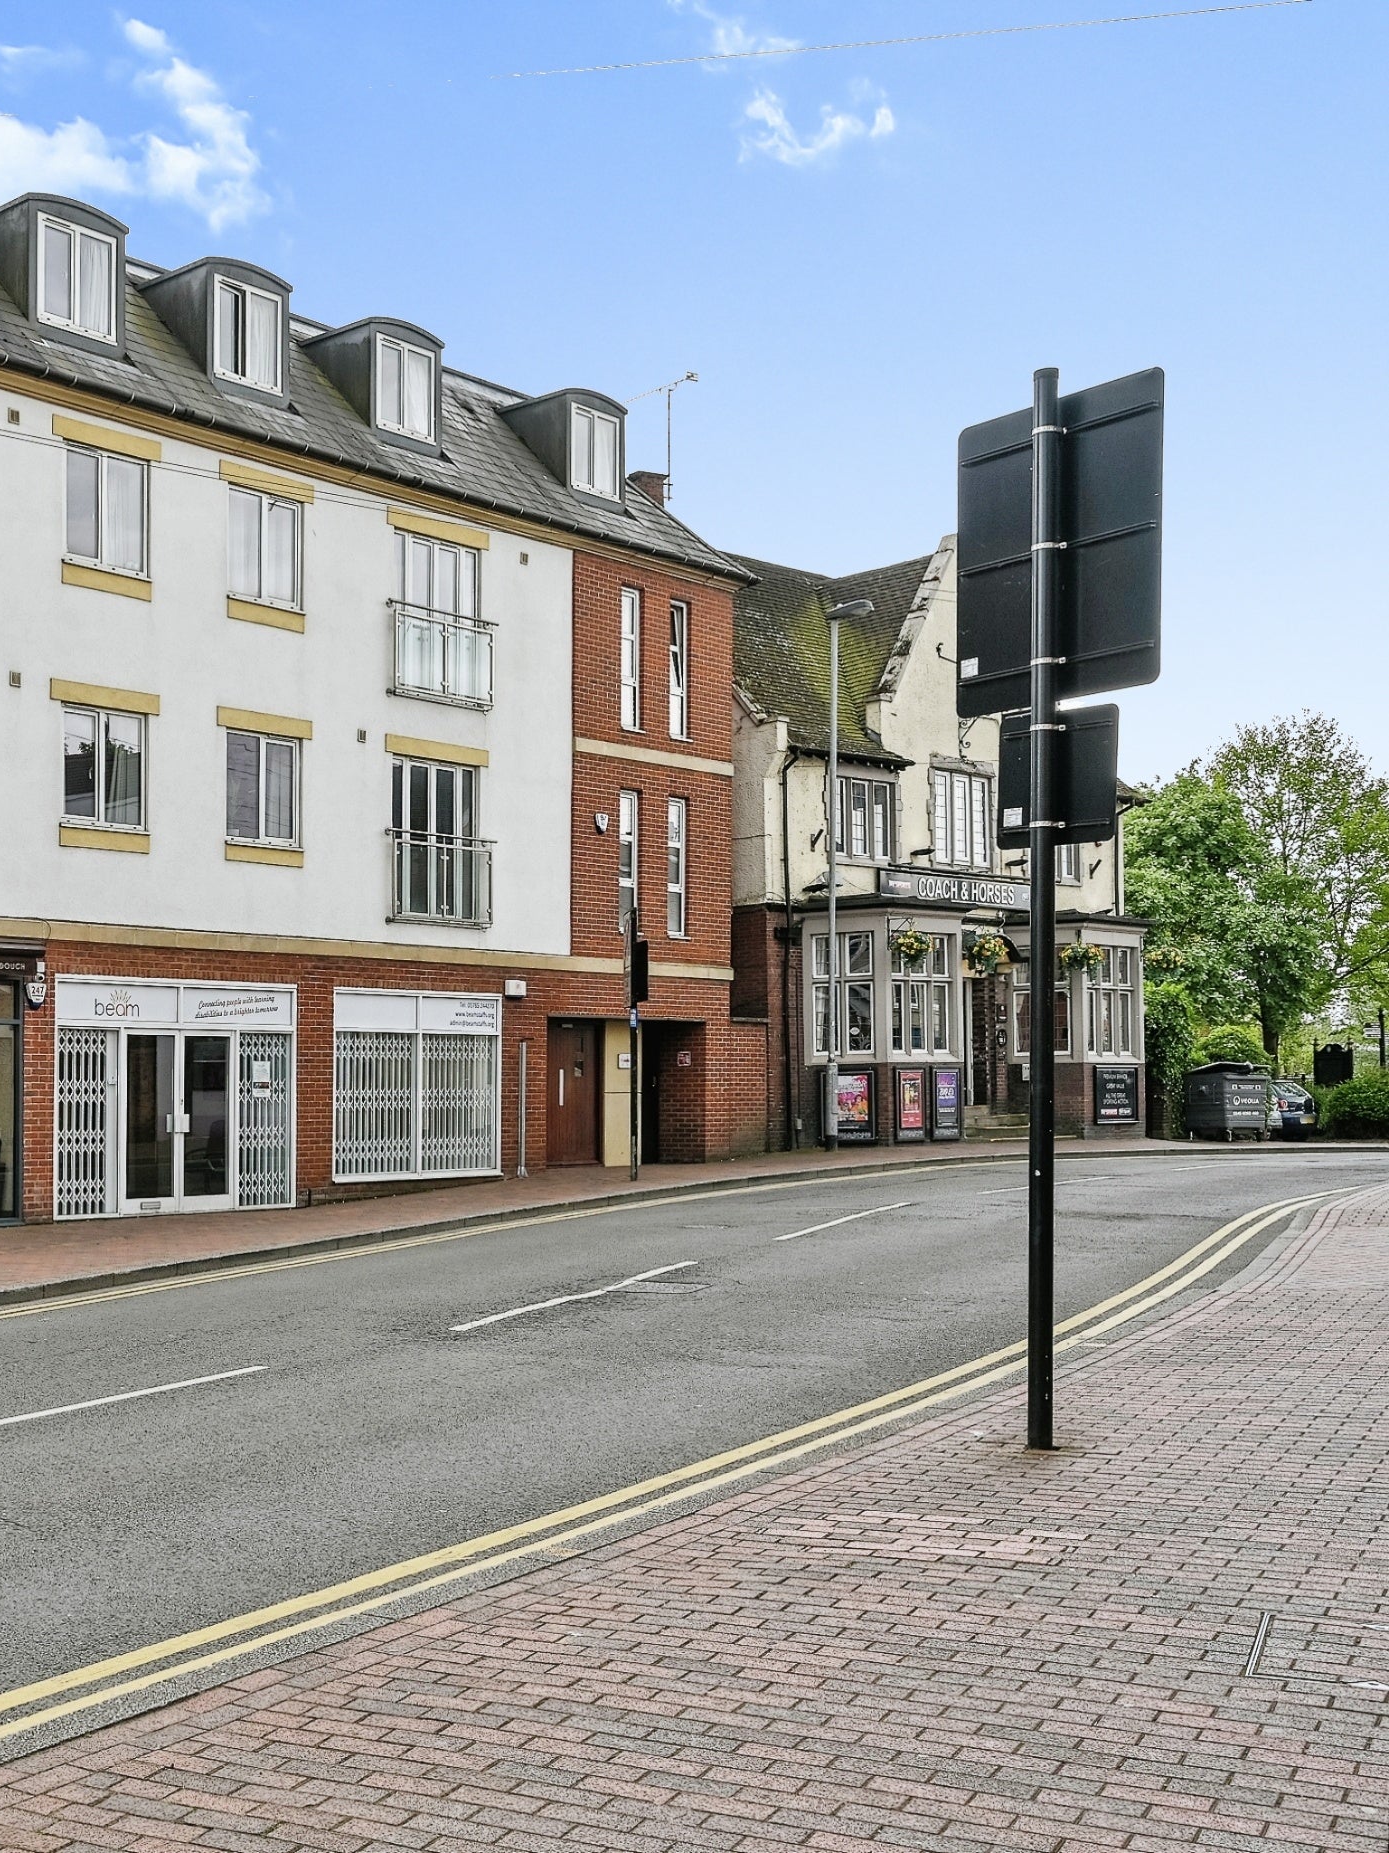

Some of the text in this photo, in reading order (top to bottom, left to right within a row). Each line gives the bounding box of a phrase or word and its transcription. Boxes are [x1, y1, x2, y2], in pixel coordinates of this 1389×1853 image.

[918, 877, 958, 899] COACH
[961, 881, 969, 900] &
[971, 882, 1015, 905] HORSES
[0, 962, 25, 971] DOUGH
[31, 986, 44, 995] 247
[94, 998, 140, 1018] beam
[199, 1000, 226, 1009] Connecting
[226, 997, 242, 1007] people
[242, 996, 253, 1004] with
[234, 1007, 254, 1017] brighter
[255, 1006, 279, 1014] tomorrow
